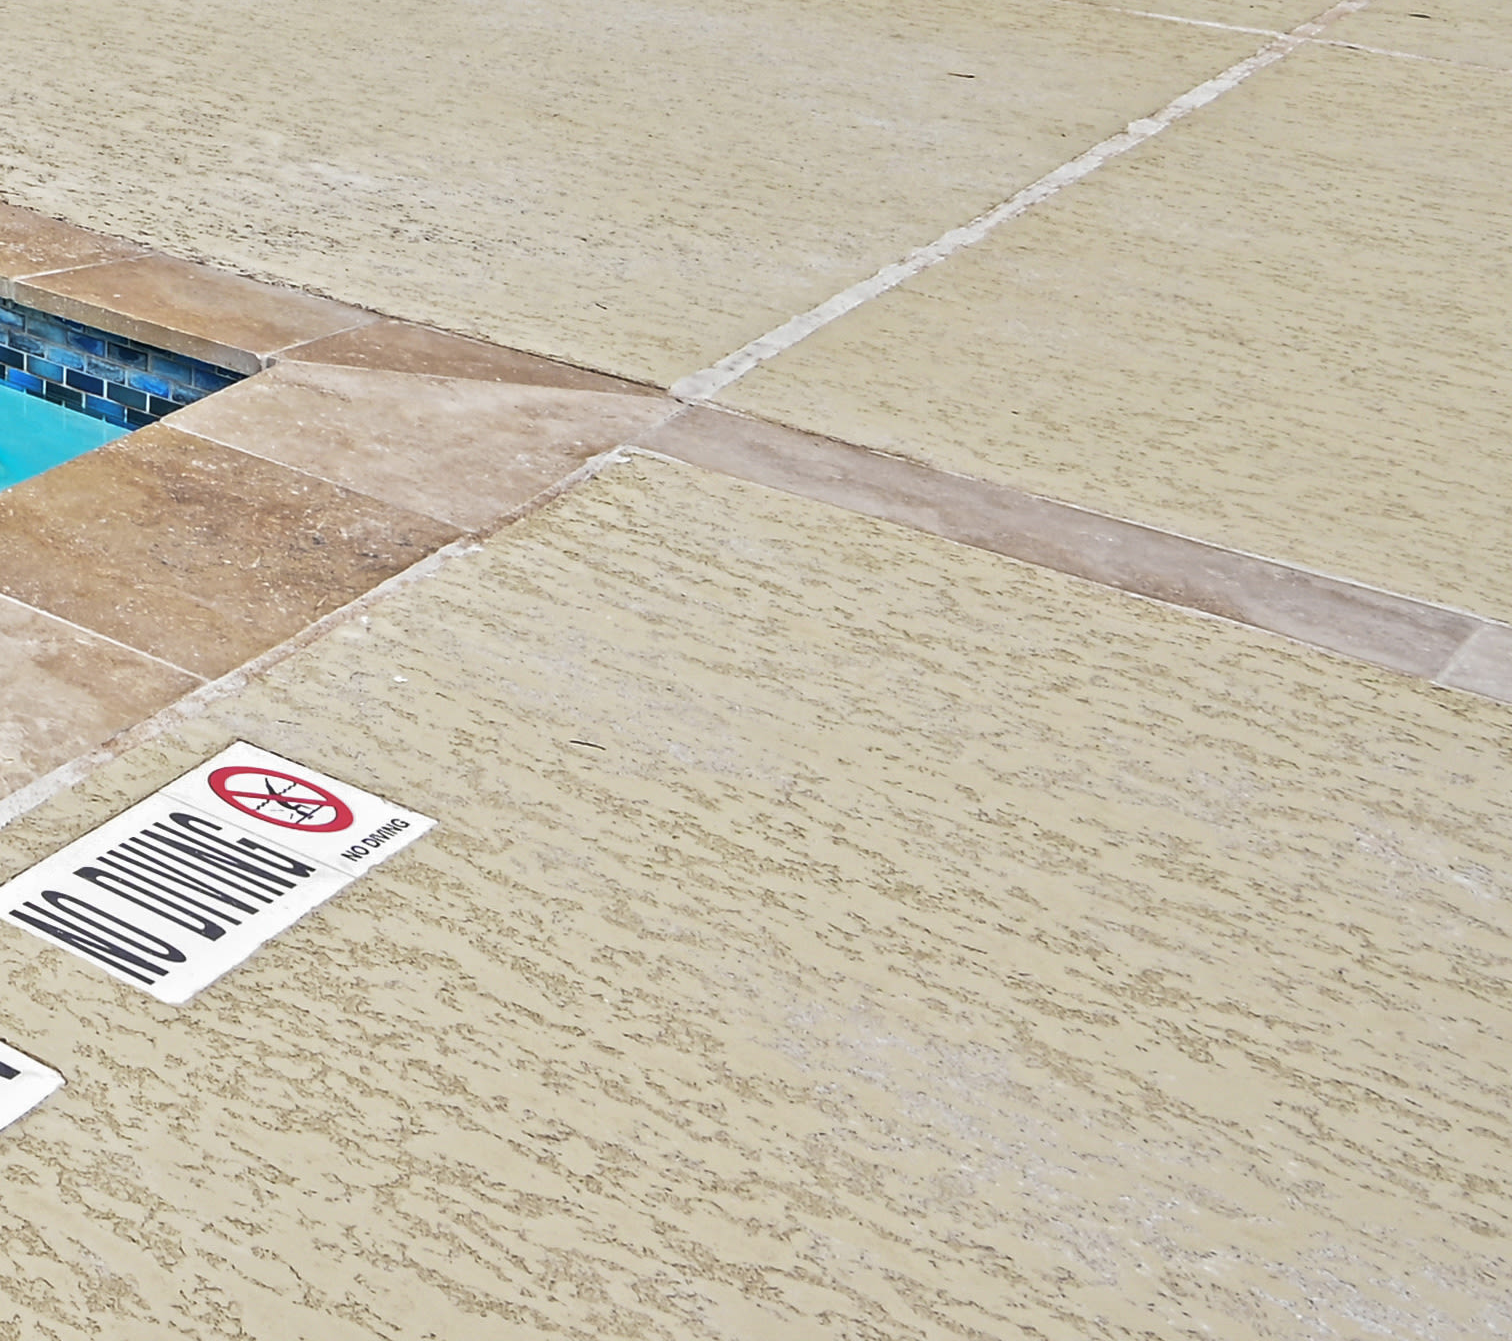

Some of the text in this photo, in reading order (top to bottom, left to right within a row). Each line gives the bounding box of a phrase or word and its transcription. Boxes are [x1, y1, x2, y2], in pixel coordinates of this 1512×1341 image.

[340, 818, 411, 862] NO DIVING
[9, 812, 317, 986] NO DIVING
